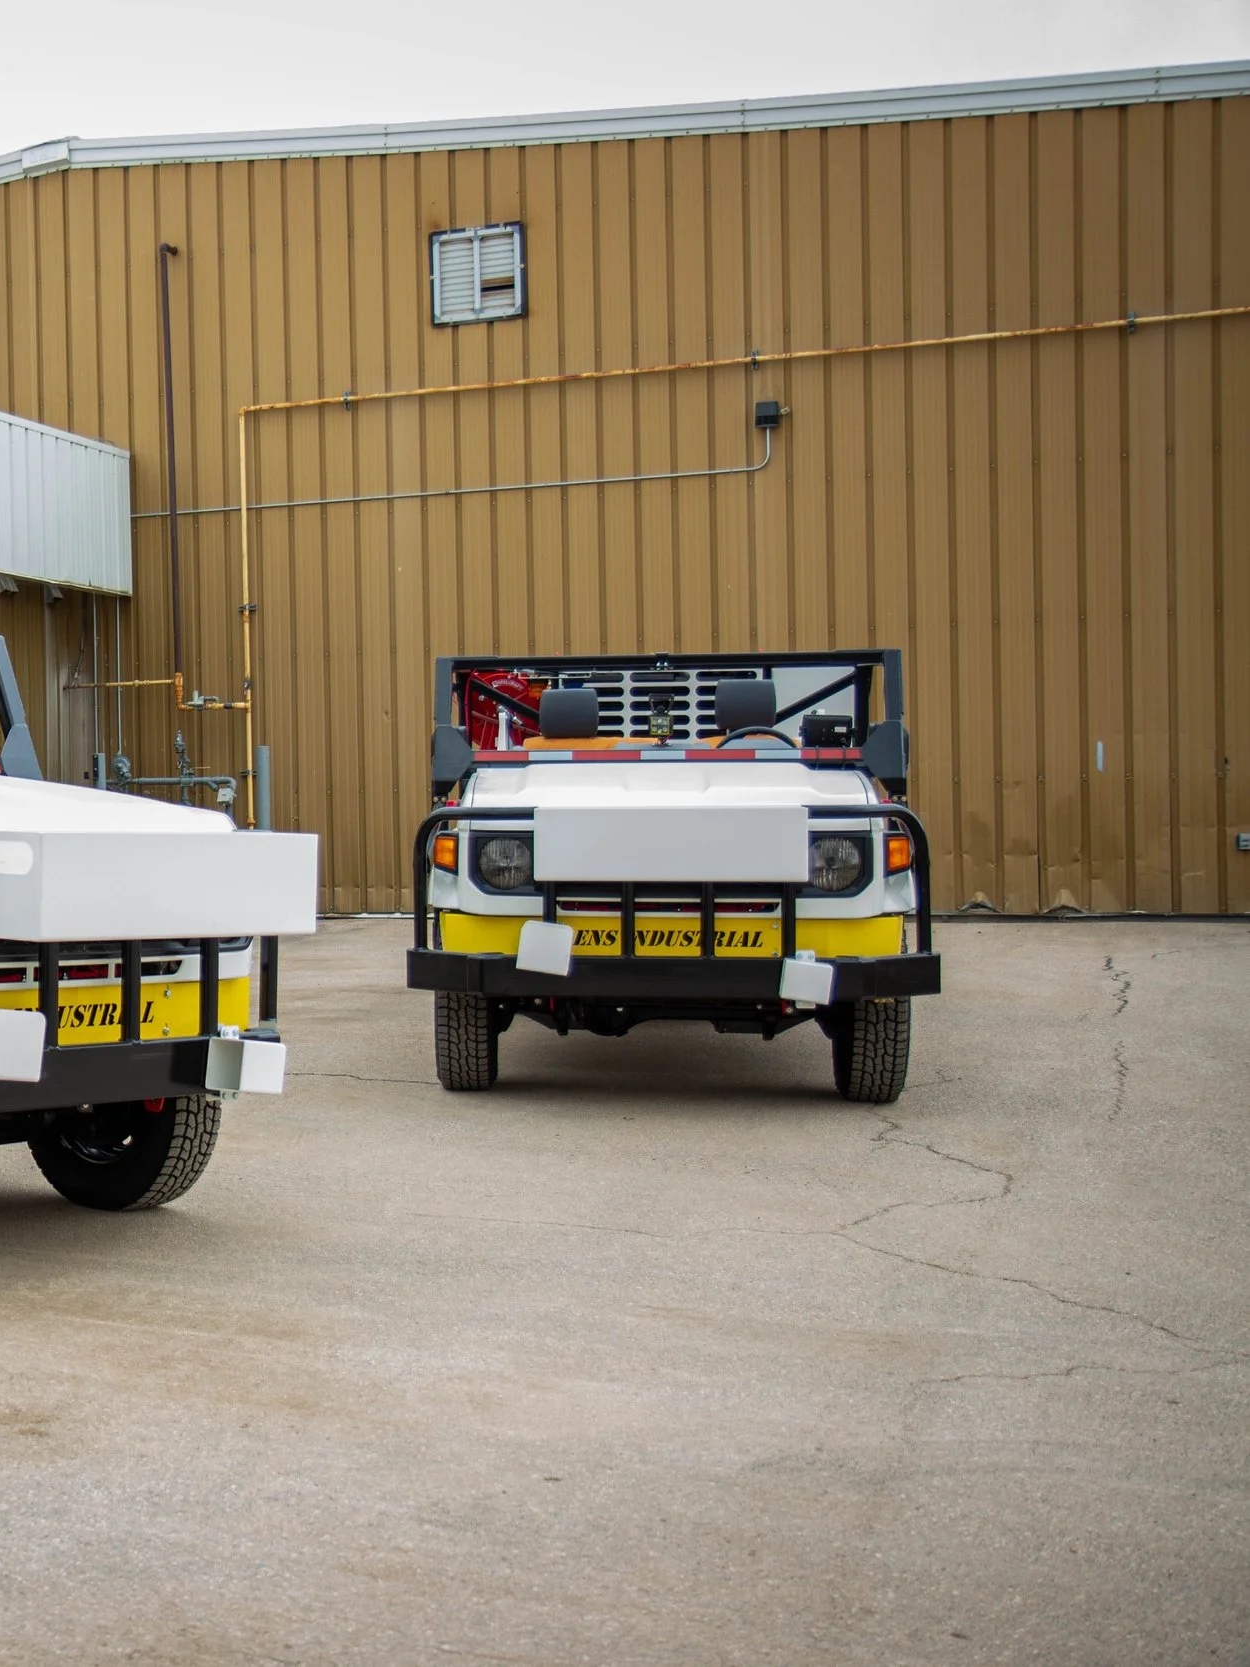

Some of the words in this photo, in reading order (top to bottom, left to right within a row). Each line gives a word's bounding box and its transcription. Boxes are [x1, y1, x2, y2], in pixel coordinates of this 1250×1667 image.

[572, 929, 619, 946] ENS
[633, 929, 764, 948] NDUSRIAL
[14, 1000, 154, 1029] USTRL
